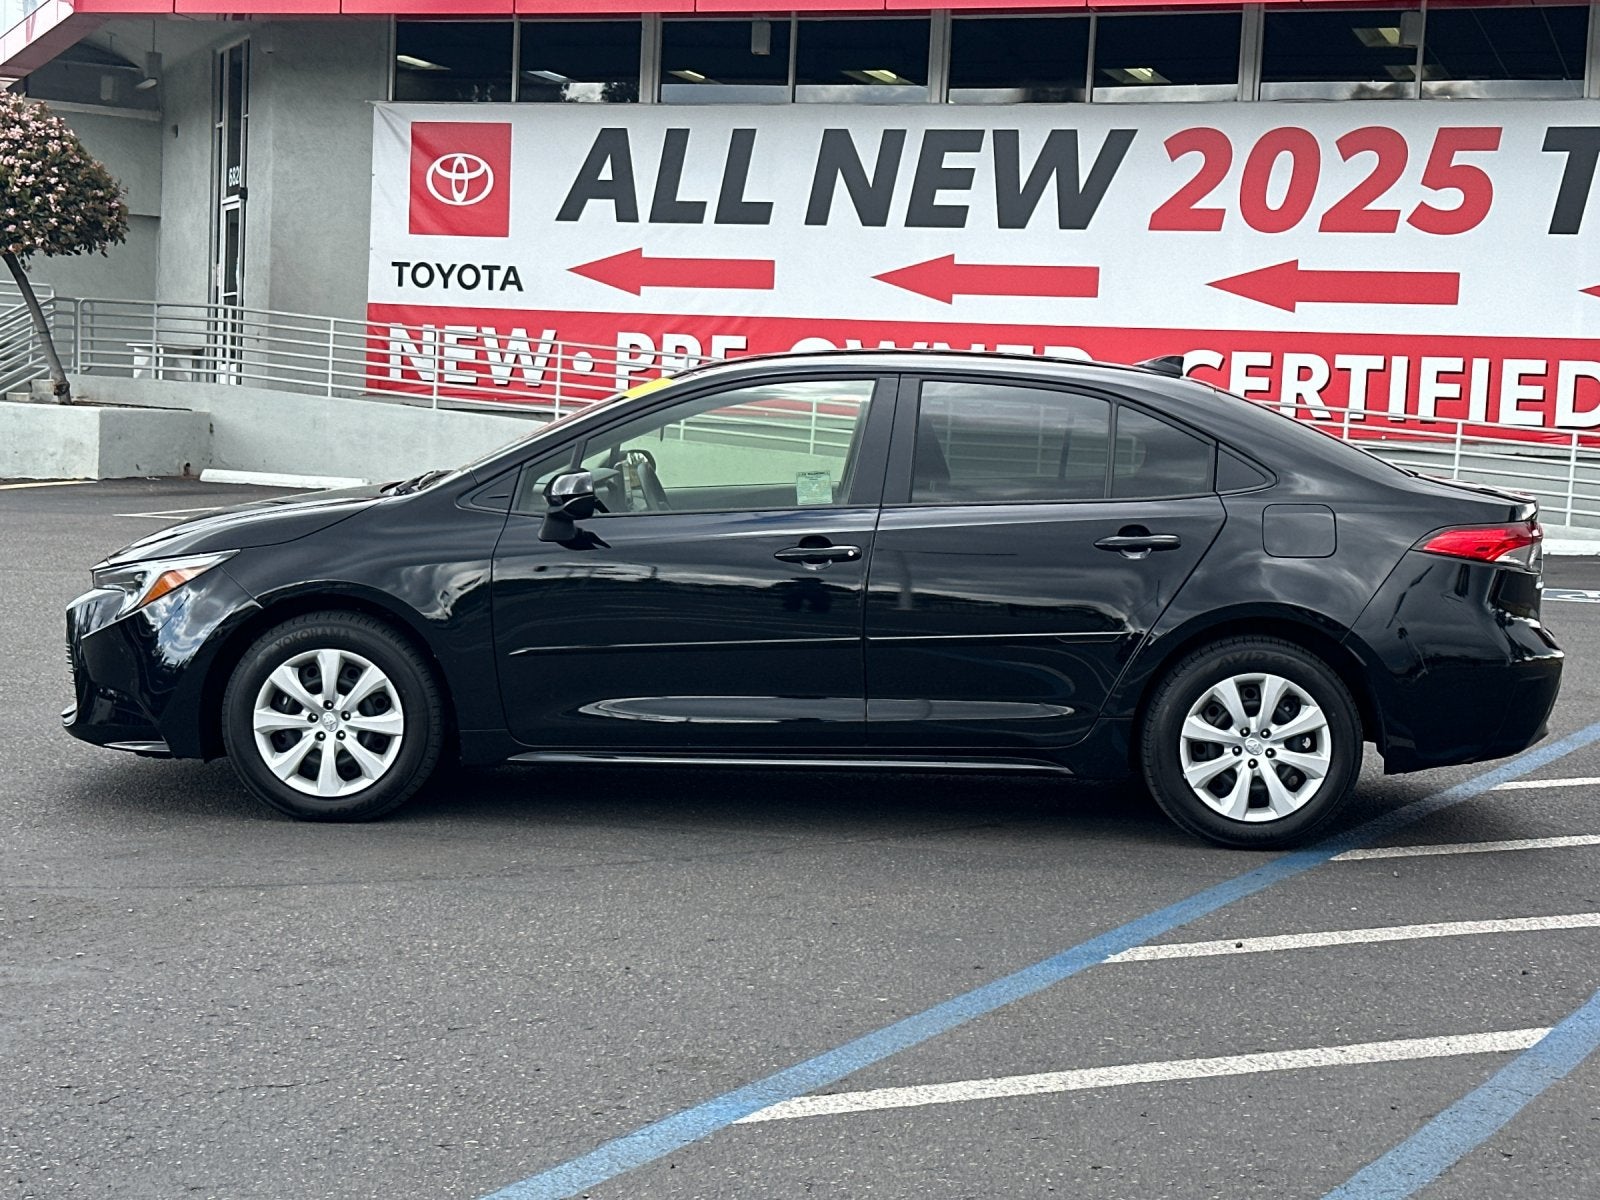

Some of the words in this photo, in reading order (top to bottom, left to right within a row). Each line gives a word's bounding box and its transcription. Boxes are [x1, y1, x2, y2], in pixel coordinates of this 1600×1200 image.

[555, 127, 774, 225] ALL
[804, 128, 1138, 230] NEW
[1148, 126, 1503, 235] 2025
[391, 261, 523, 292] TOYOTA
[389, 322, 557, 387] NEW
